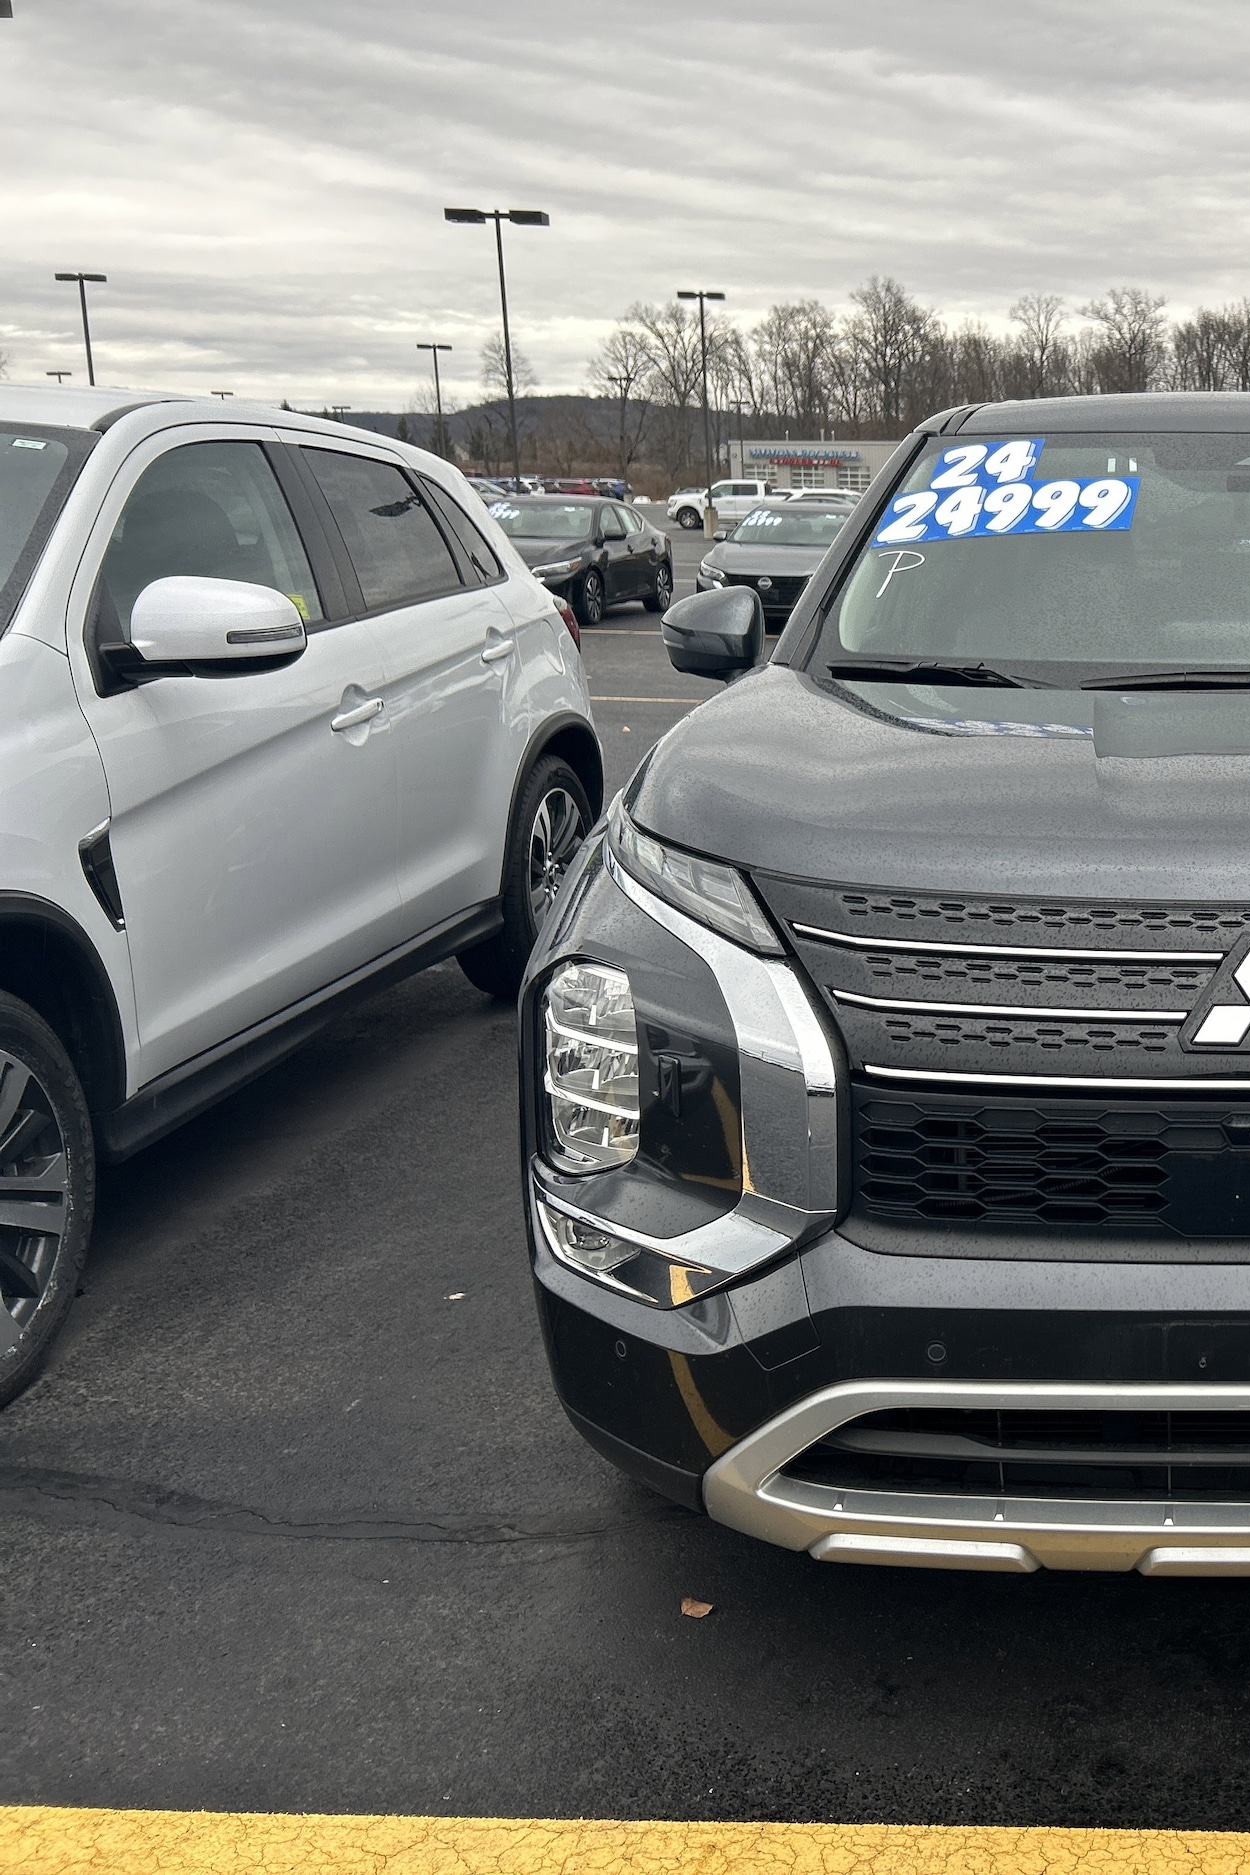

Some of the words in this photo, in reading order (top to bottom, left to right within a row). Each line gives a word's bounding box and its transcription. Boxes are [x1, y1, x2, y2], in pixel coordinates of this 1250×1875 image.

[930, 440, 1036, 489] 24
[876, 478, 1132, 543] 24999
[875, 550, 926, 599] P
